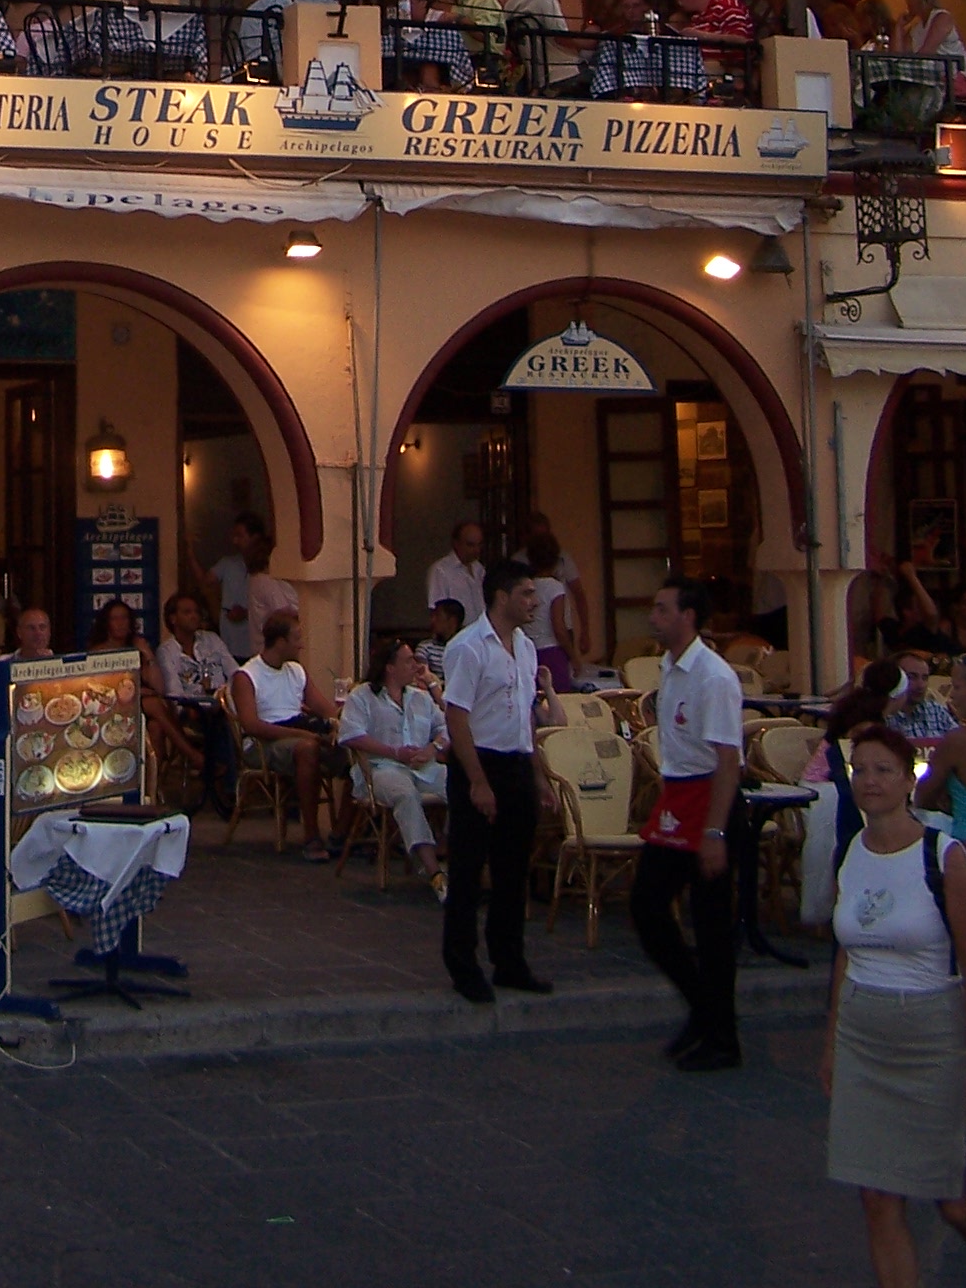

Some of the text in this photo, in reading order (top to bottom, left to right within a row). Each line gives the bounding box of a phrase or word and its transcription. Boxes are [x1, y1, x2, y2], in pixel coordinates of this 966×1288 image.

[89, 85, 256, 126] STEAK
[401, 97, 587, 141] GREEK
[93, 124, 254, 151] HOUSE
[279, 139, 375, 155] Archipelagos
[404, 136, 584, 163] RESTAURANT
[602, 117, 742, 159] PIZZERIA
[526, 371, 632, 380] RESTAURANT
[527, 354, 631, 374] GREEK
